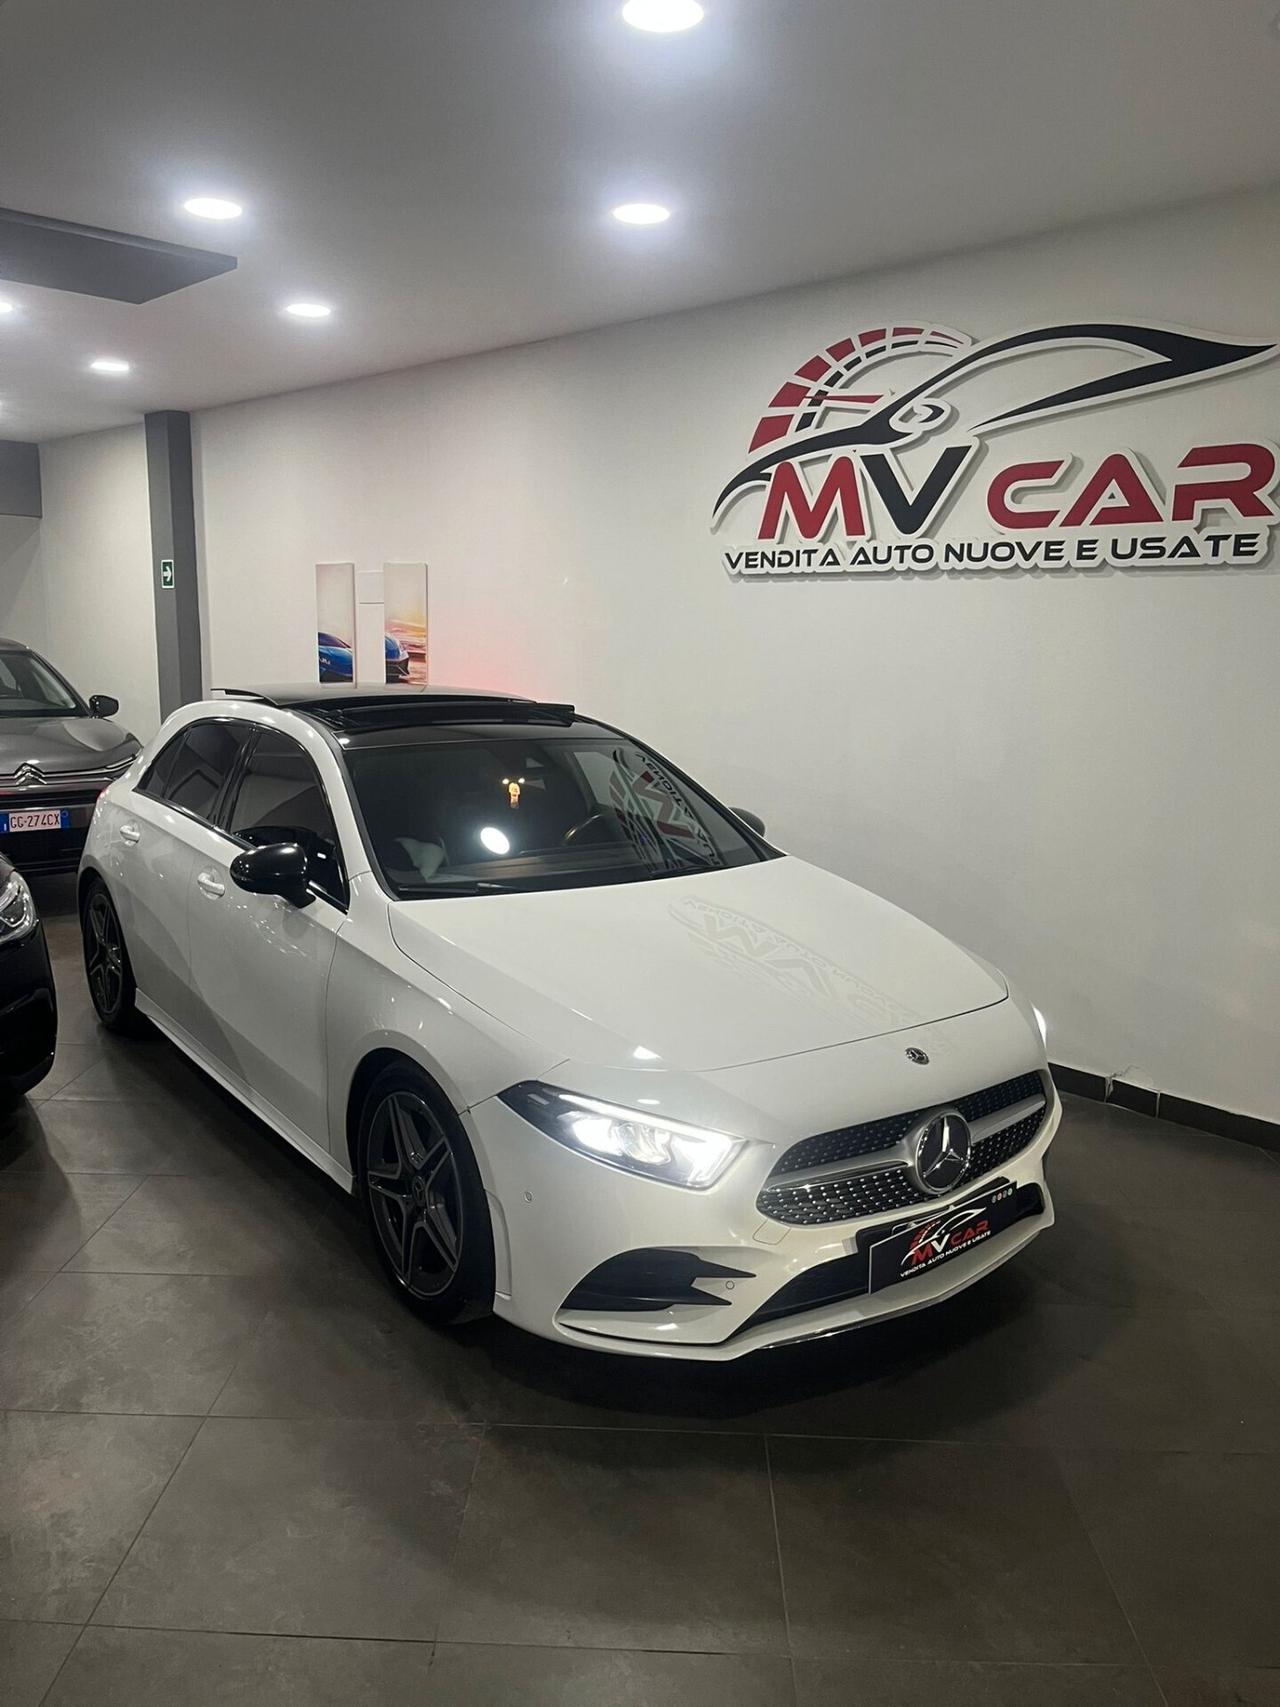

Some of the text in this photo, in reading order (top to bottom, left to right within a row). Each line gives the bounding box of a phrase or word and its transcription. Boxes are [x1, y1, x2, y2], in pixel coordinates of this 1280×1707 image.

[987, 443, 1275, 530] CAR
[725, 533, 1261, 570] VENDITA AUTO NUOVE E USATE
[900, 1263, 926, 1277] VENDITA
[927, 1253, 945, 1265] AUTO
[945, 1241, 967, 1256] NUOVE
[972, 1230, 991, 1243] USATE
[911, 1220, 988, 1265] MV CAR
